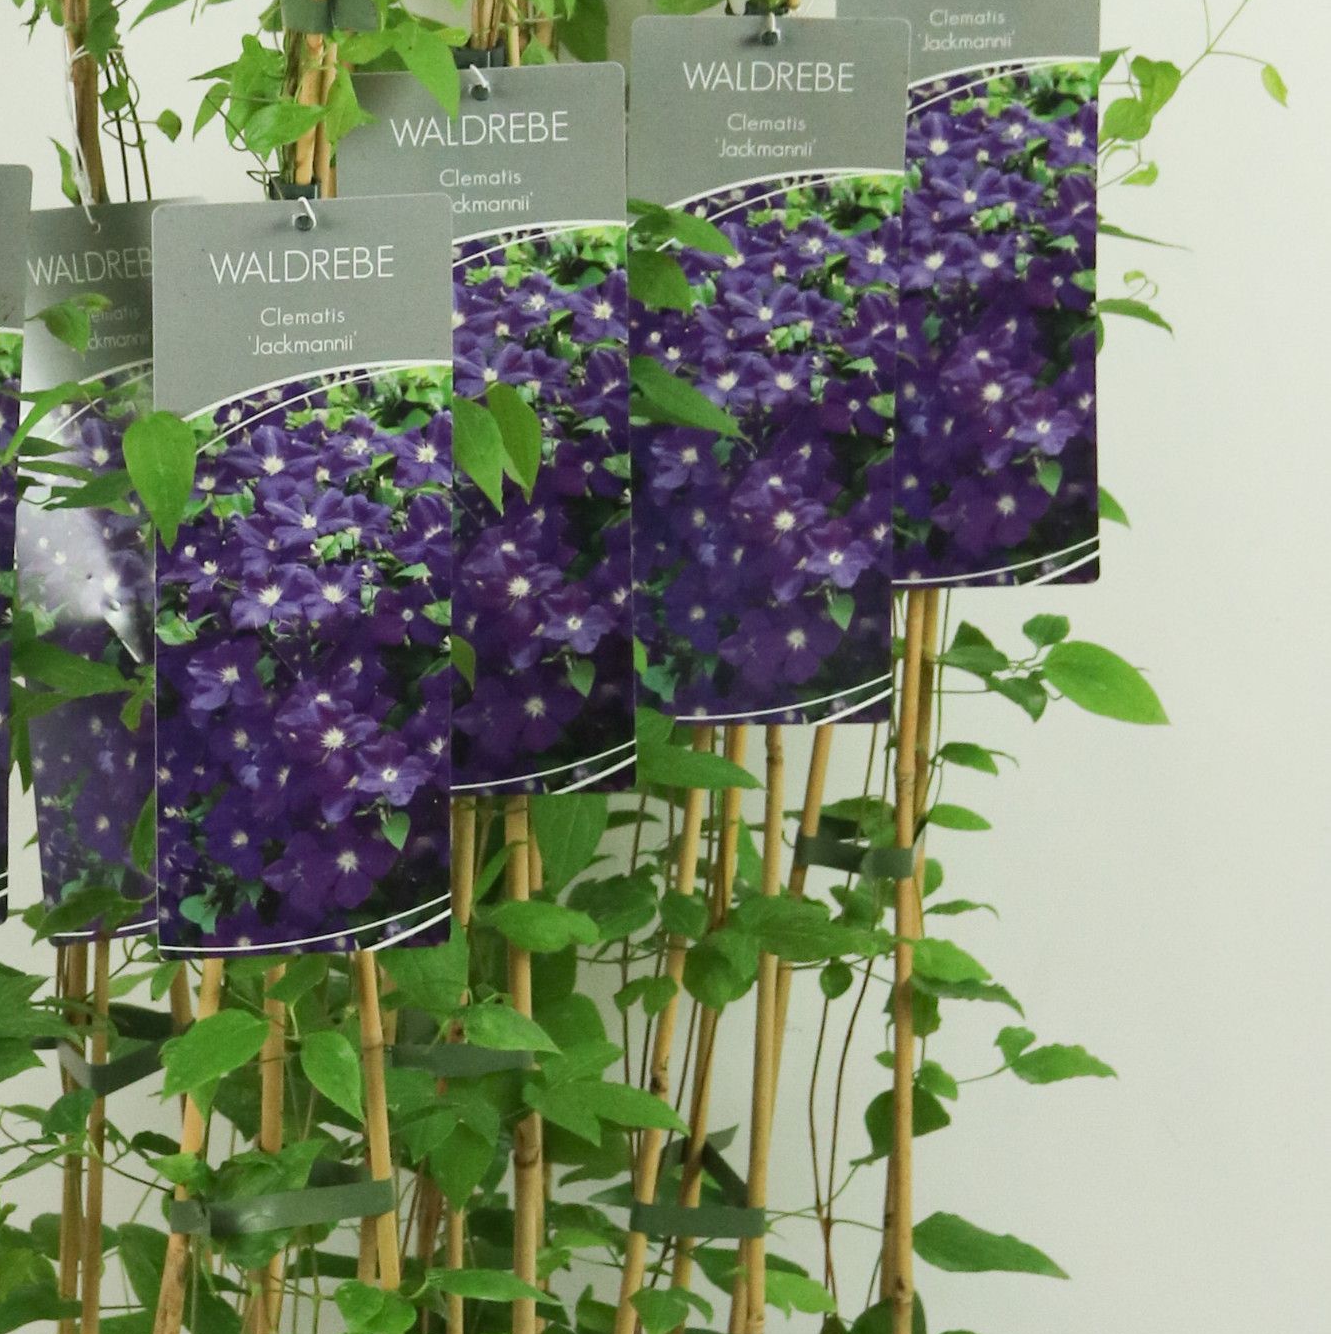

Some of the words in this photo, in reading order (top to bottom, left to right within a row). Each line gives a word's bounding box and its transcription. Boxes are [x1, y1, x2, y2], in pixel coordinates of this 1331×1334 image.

[930, 9, 1005, 26] Clematis
[683, 61, 854, 92] WALDREBE
[390, 111, 568, 147] WALDREBE
[727, 113, 806, 131] Clematis
[440, 168, 521, 187] Clematis
[26, 248, 153, 286] WALDREB
[209, 245, 393, 284] WALDREBE
[260, 307, 345, 326] Clematis
